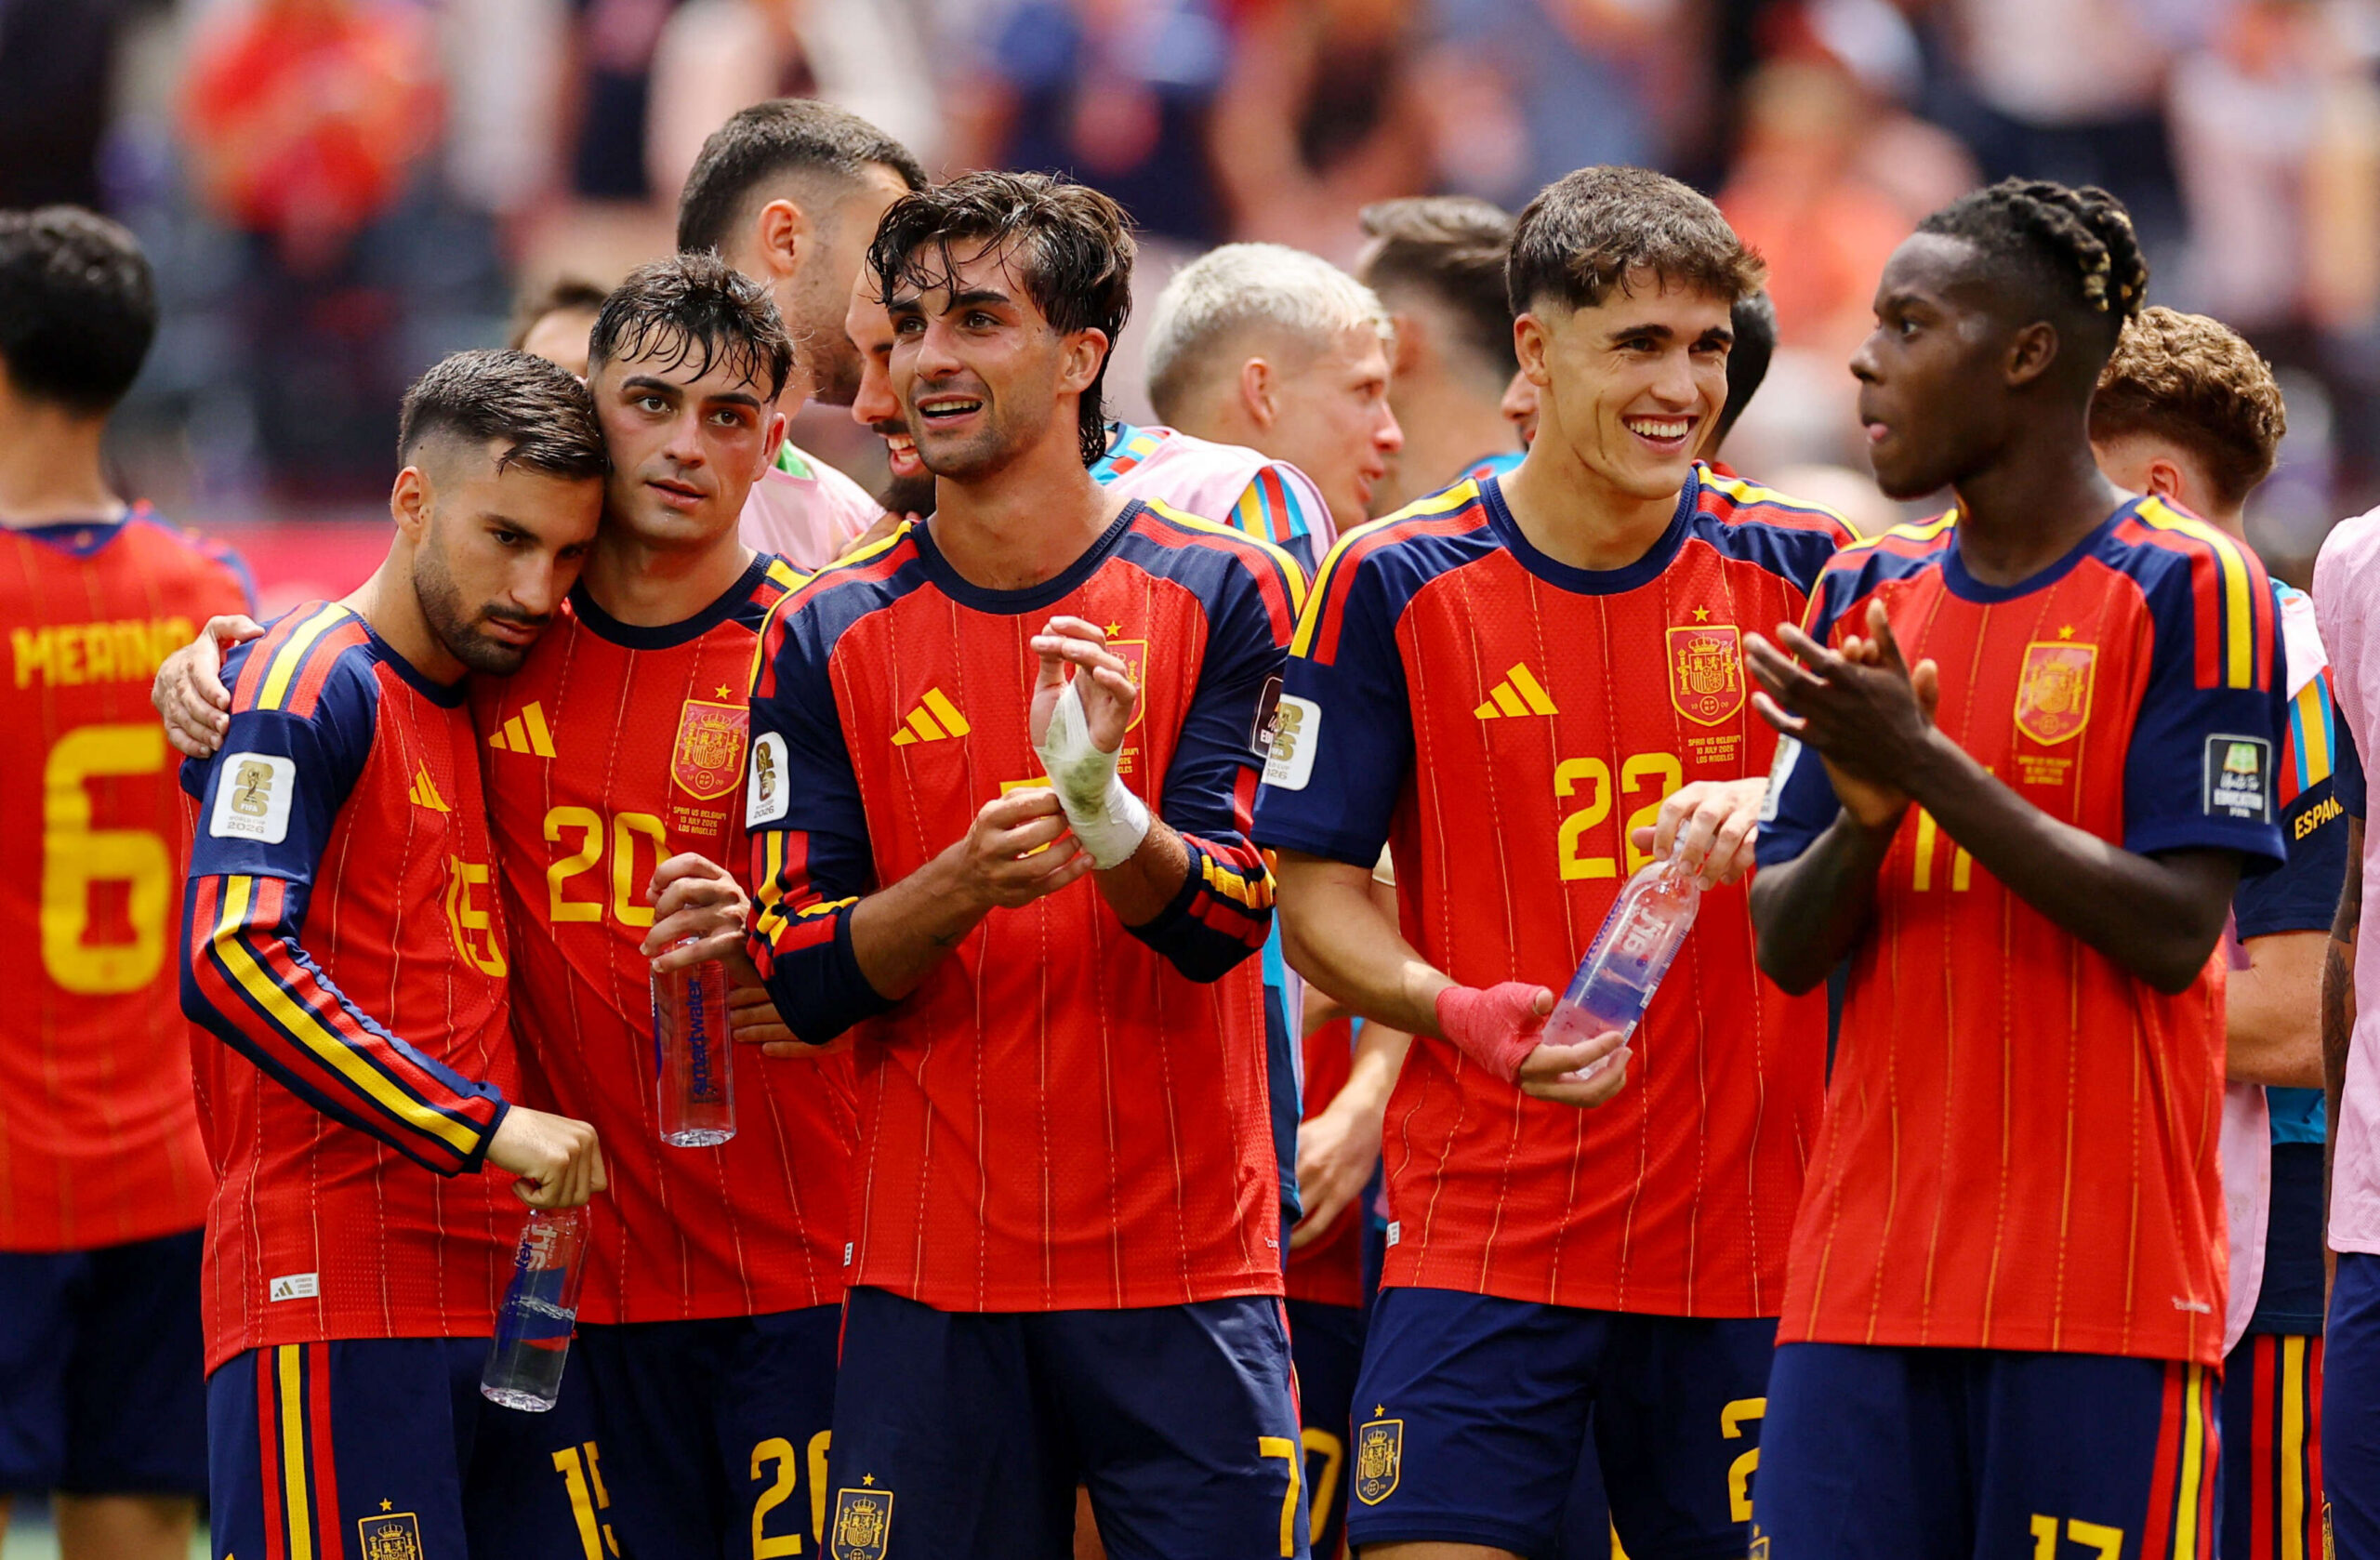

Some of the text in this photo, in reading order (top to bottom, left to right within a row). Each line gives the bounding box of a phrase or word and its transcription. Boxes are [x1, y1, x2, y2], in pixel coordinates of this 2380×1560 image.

[42, 725, 169, 995] 6
[227, 821, 265, 834] 2026
[544, 806, 672, 927] 20
[1554, 752, 1683, 880] 22
[446, 853, 508, 977] 15
[1258, 1436, 1301, 1557] 7
